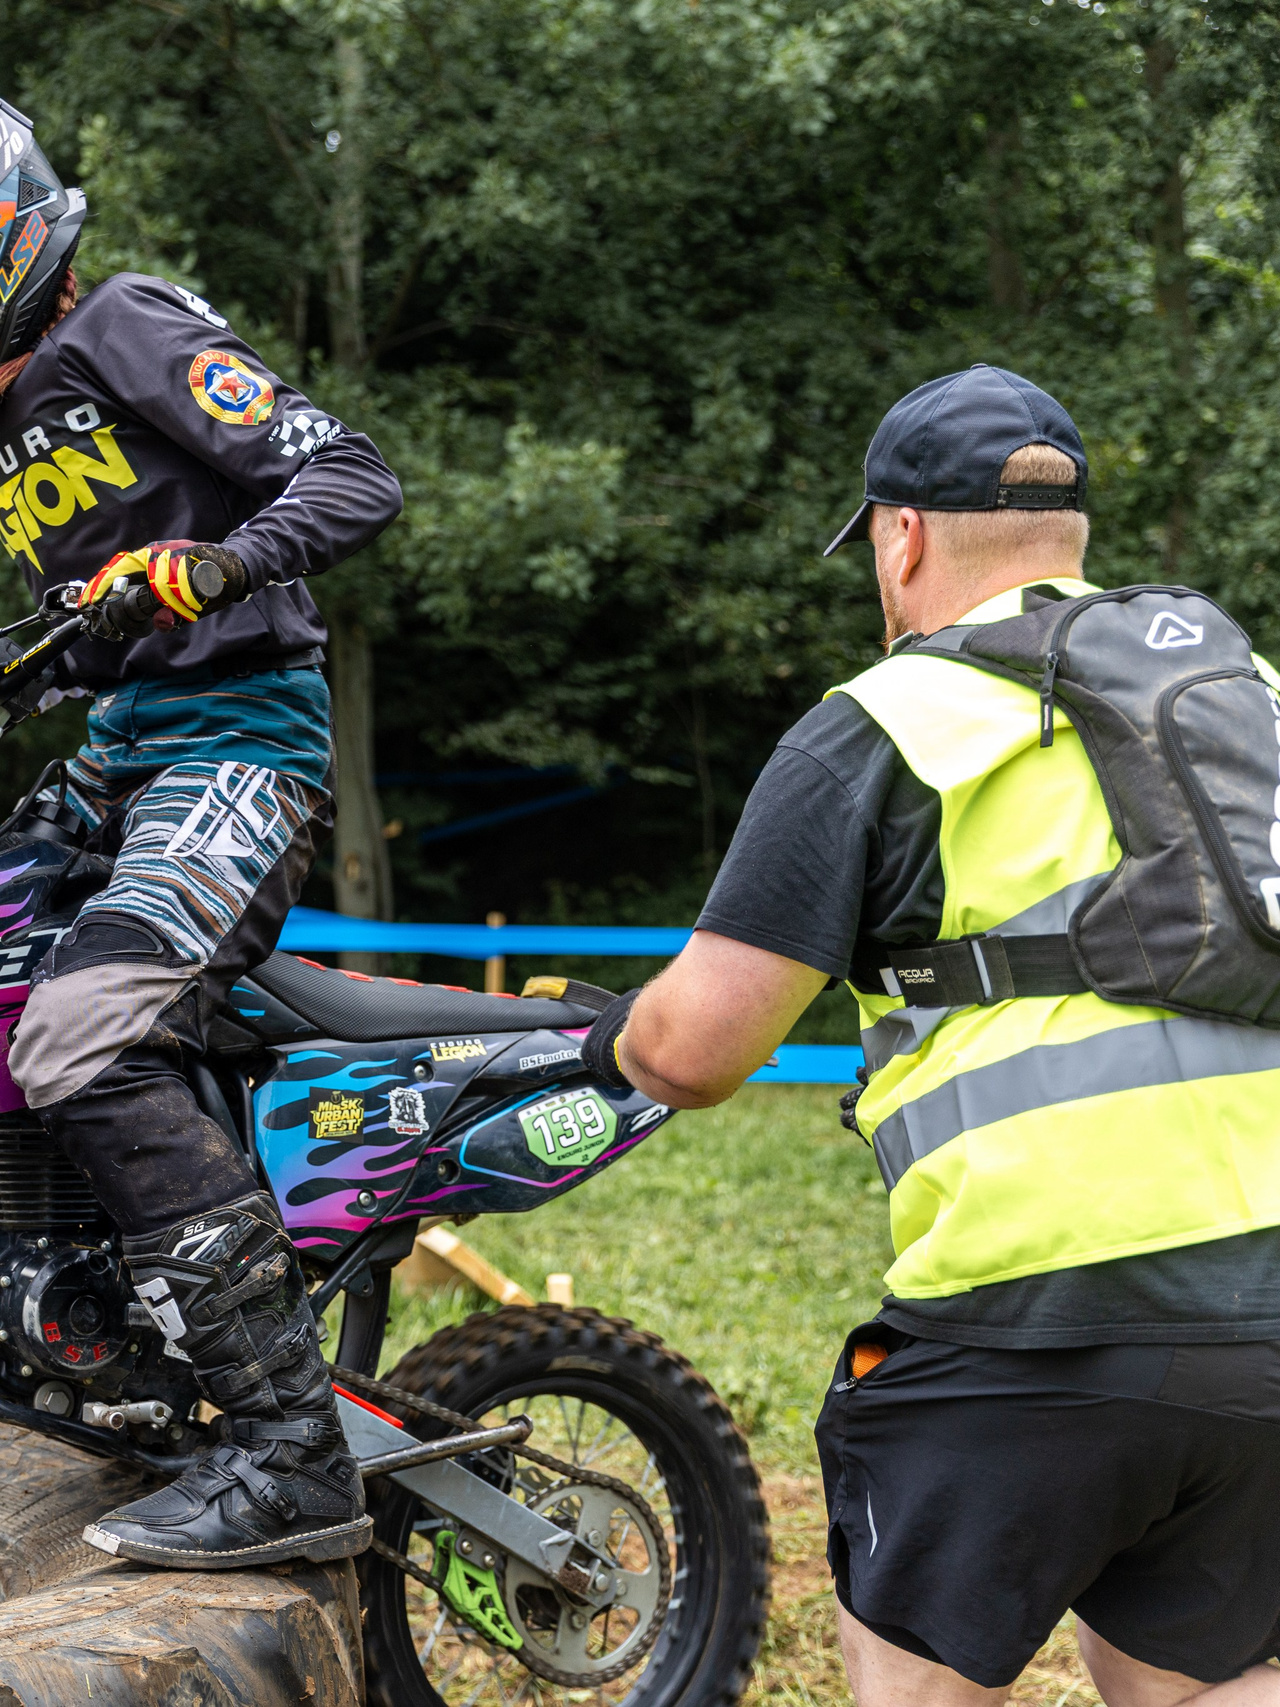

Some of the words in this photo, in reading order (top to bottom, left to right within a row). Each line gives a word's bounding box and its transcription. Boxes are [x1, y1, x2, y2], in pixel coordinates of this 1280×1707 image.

[897, 967, 934, 979] ACQUA
[430, 1038, 482, 1048] ENDURO
[431, 1044, 487, 1063] LEGION
[315, 1108, 361, 1123] URBAN
[320, 1119, 357, 1134] FEST
[532, 1097, 607, 1155] 139
